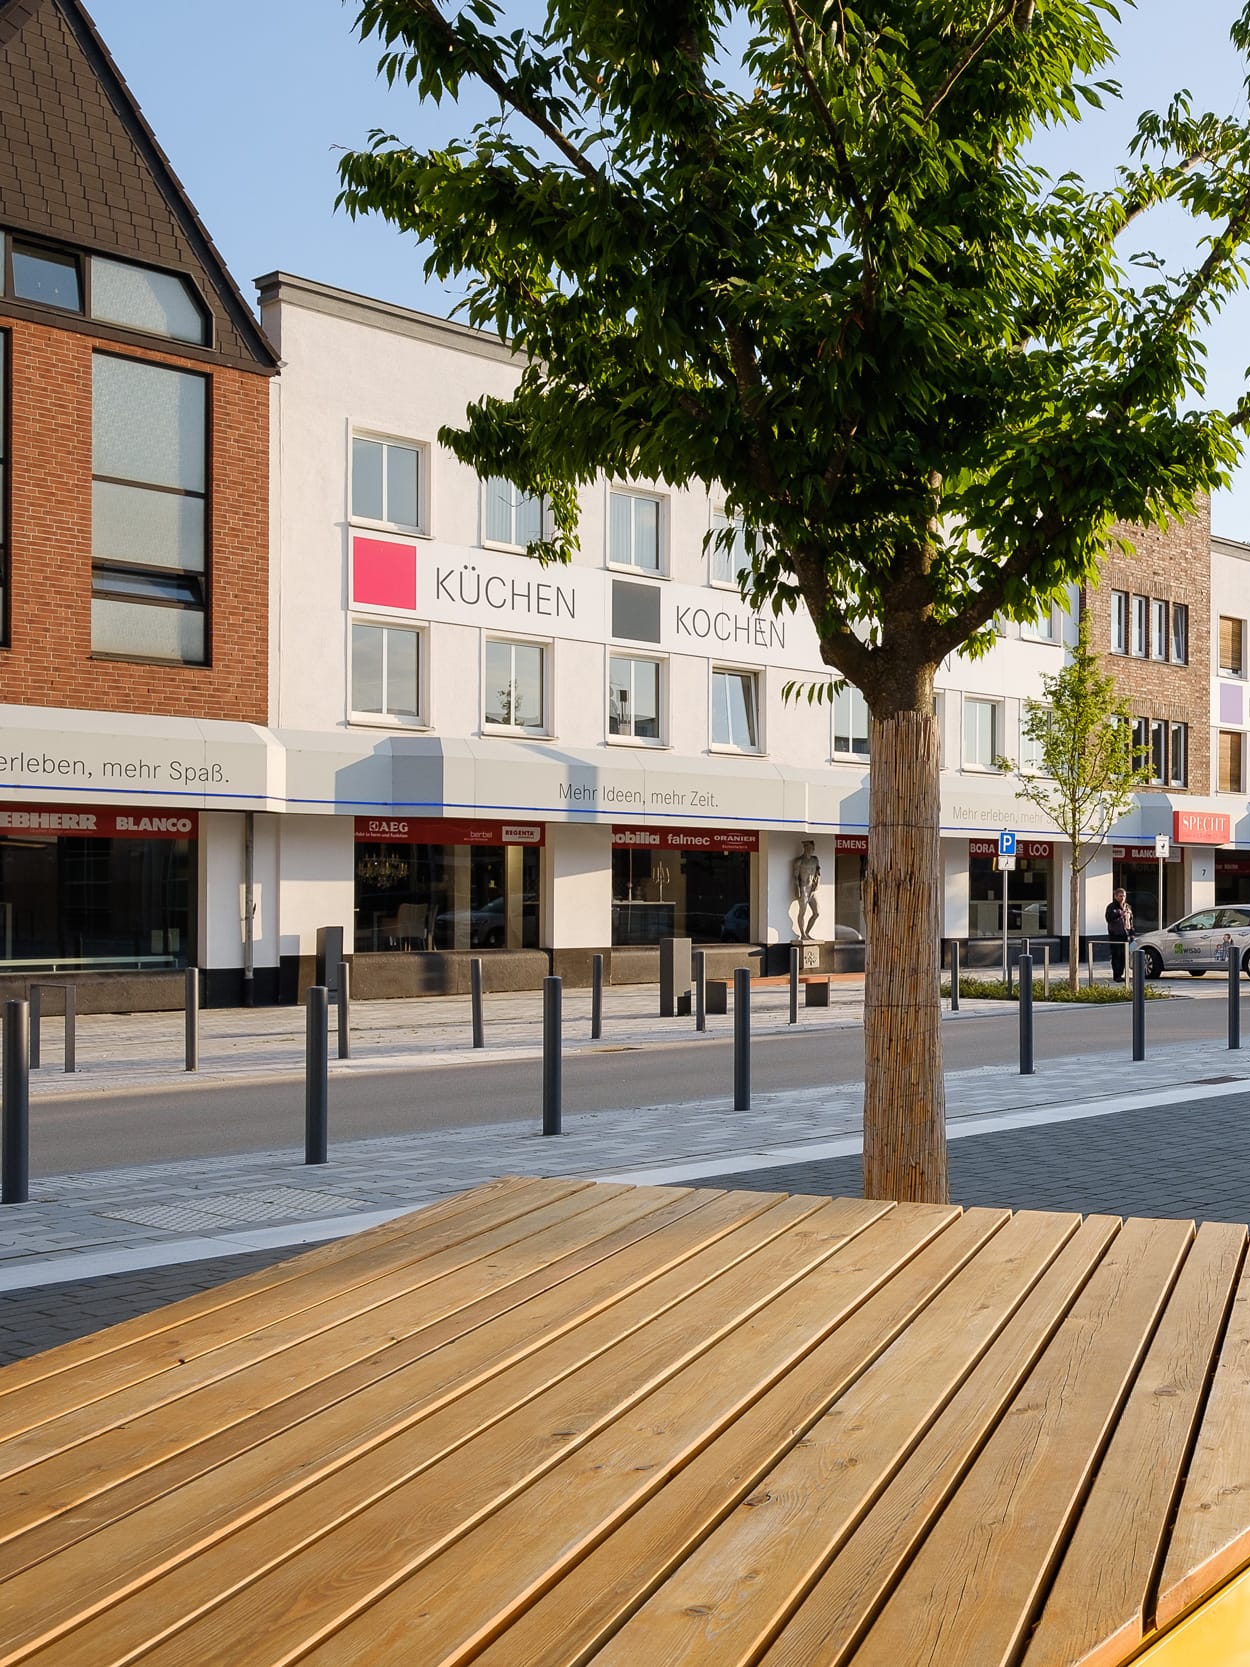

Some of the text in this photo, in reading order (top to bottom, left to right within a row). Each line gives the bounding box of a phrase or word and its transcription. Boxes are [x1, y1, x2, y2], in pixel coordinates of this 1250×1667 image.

[436, 564, 576, 620] KÜCHEN
[675, 605, 786, 649] KOCHEN
[0, 752, 230, 785] erleben, mehr Spaß.
[559, 783, 719, 808] Mehr Ideen, mehr Zeit.
[115, 816, 192, 832] BLANCO
[952, 806, 978, 820] Mehr
[980, 810, 1018, 824] erleben,
[1020, 812, 1044, 823] mehr
[1182, 815, 1226, 833] SPECHT
[379, 822, 409, 832] AEG
[667, 834, 711, 845] falmec
[970, 842, 995, 854] BORA
[1003, 834, 1012, 852] P
